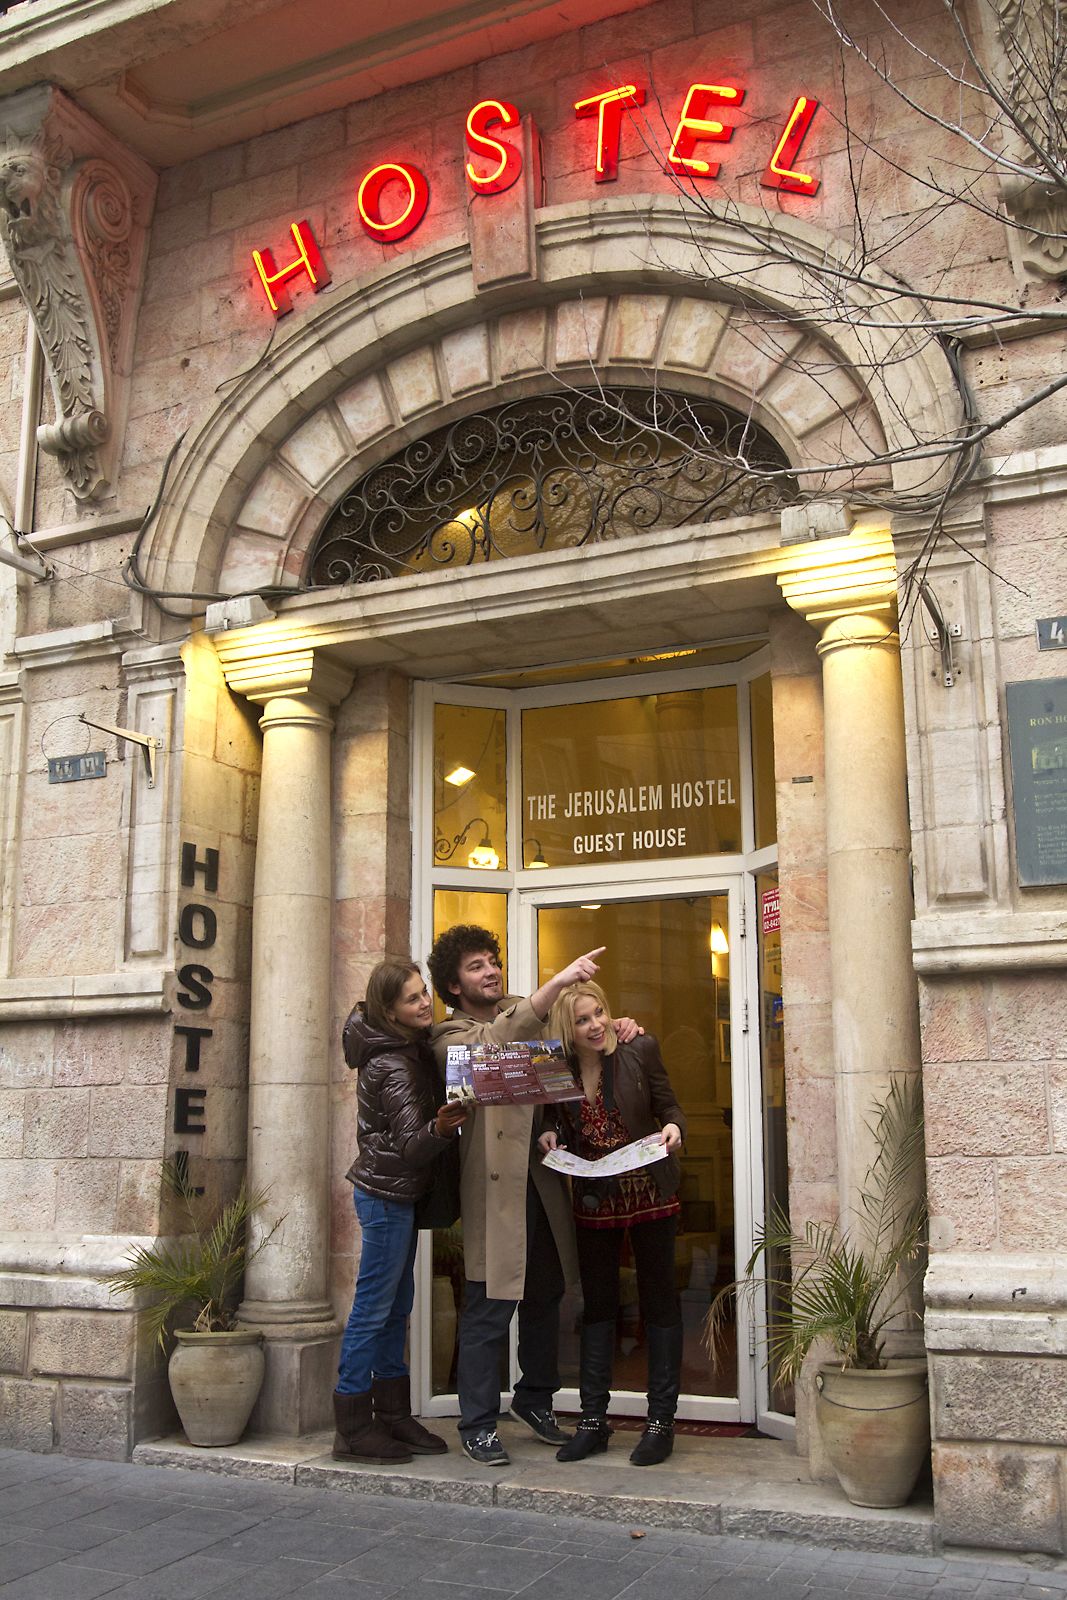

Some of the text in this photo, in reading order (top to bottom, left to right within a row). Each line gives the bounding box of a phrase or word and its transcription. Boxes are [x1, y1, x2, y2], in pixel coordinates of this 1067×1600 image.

[252, 83, 820, 318] HOSTEL
[1030, 717, 1052, 727] RON
[527, 778, 736, 821] THE JERUSALEM HOSTEL
[573, 827, 686, 854] GUEST HOUSE
[447, 1051, 471, 1061] FREE
